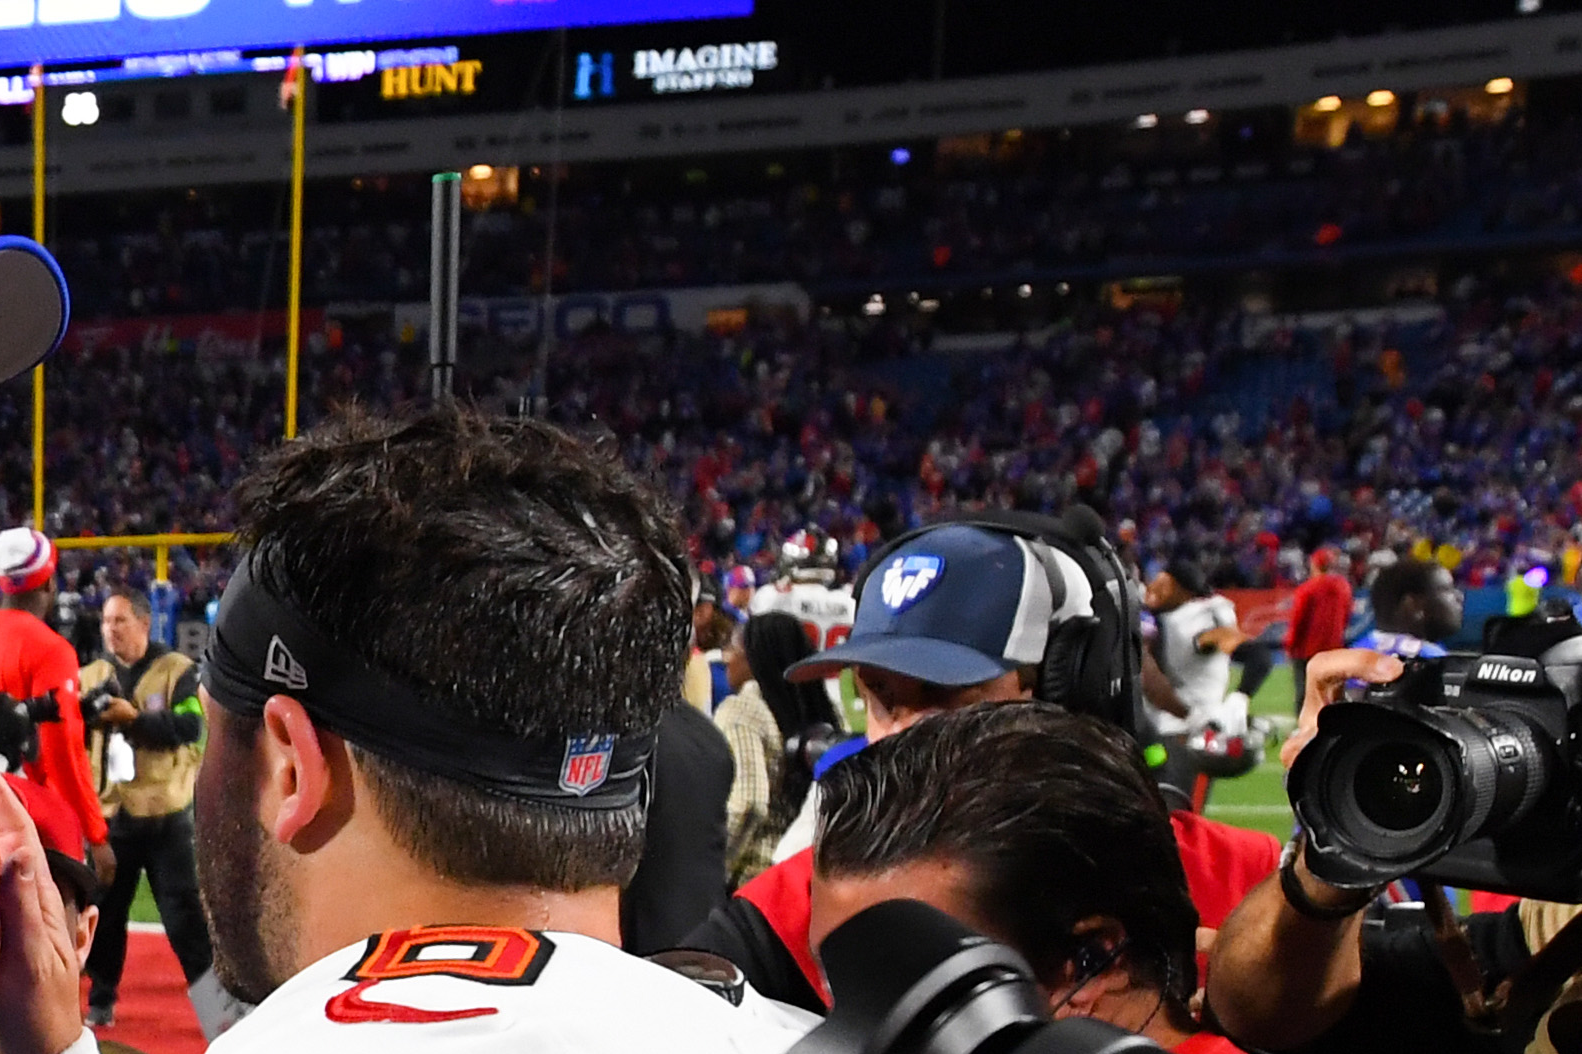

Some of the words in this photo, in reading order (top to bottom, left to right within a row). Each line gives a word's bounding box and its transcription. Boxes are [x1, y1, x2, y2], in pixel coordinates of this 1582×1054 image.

[633, 40, 779, 79] IMAGINE
[380, 59, 483, 100] HUNT
[1476, 663, 1537, 683] Nikon
[566, 754, 604, 786] NFL
